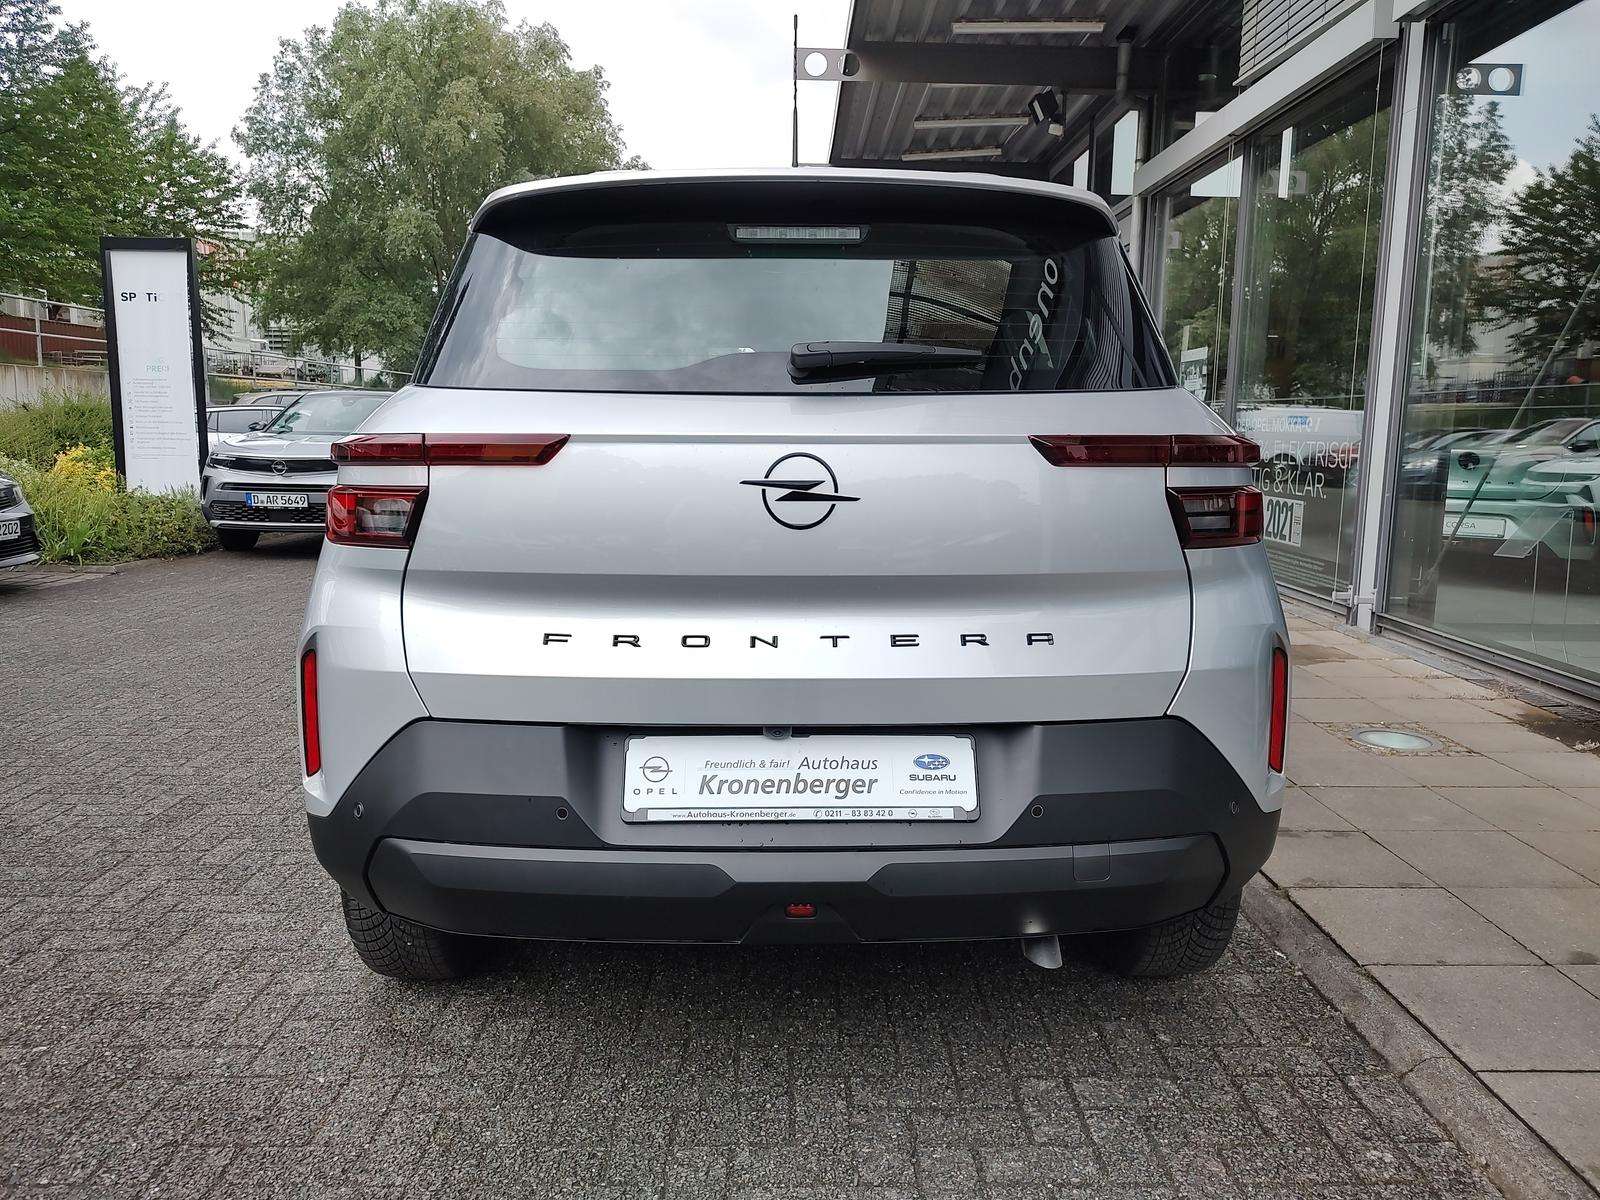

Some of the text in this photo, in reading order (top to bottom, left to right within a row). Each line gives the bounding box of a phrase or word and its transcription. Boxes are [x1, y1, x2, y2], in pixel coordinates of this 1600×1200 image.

[1273, 440, 1362, 469] ELEKTRISCH
[1273, 469, 1284, 493] &
[1287, 470, 1327, 499] KLAR.
[252, 495, 306, 506] D AR 5649
[1265, 498, 1294, 543] 2021
[0, 522, 19, 536] 202
[542, 633, 1055, 649] FRONTERA
[704, 756, 879, 770] Freundlich & fair! Autohaus
[909, 774, 957, 782] SUBARU
[633, 788, 678, 796] OPEL
[698, 773, 879, 800] Kronenberger
[824, 810, 843, 818] 0211
[851, 810, 862, 818] 83
[863, 810, 874, 818] 83
[875, 810, 886, 818] 42
